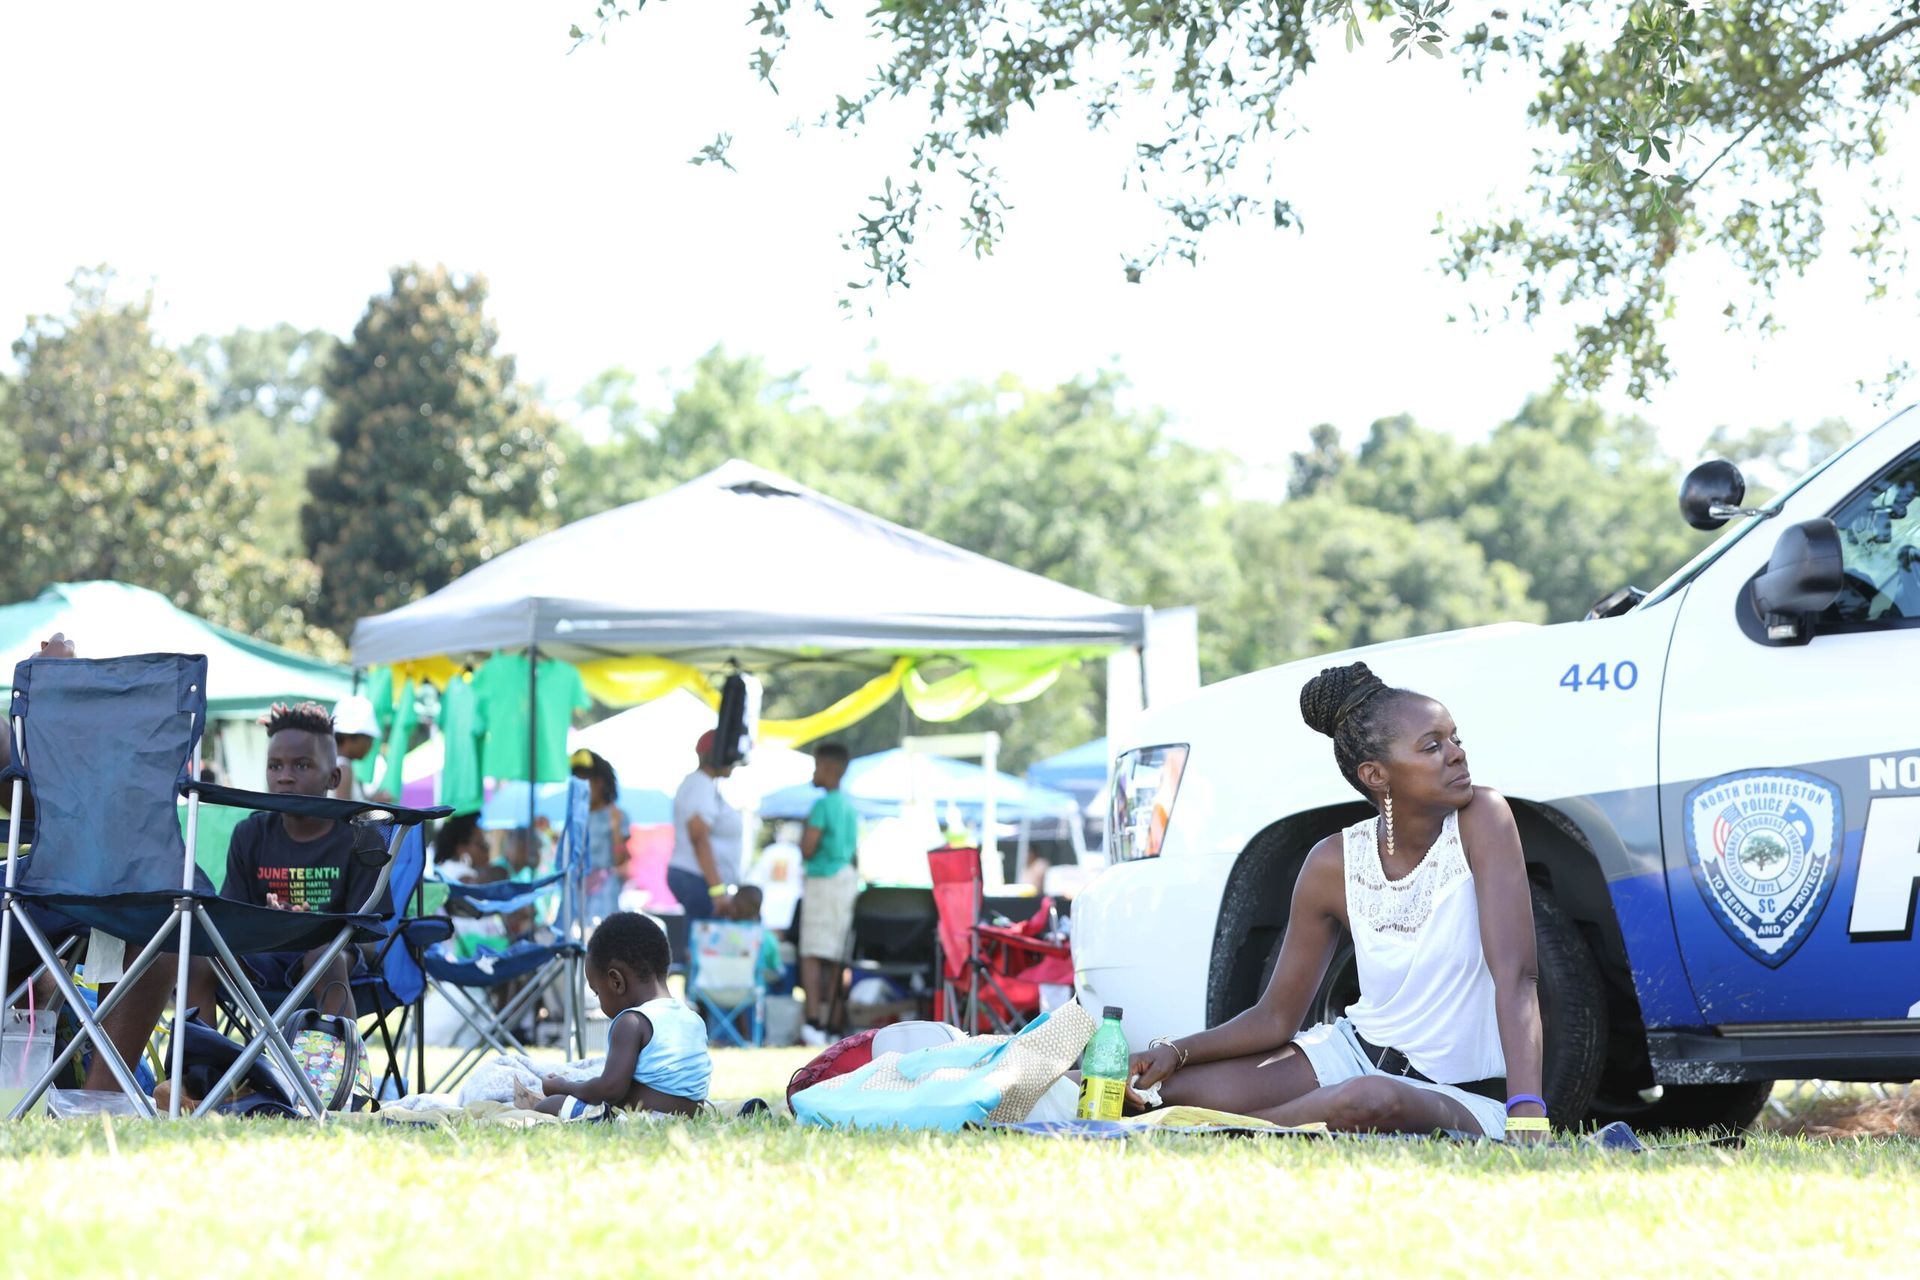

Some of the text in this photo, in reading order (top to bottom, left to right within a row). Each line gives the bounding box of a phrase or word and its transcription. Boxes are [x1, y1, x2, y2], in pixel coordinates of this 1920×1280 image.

[1560, 660, 1638, 692] 440
[1700, 782, 1824, 811] NORTH CHARLESTON
[1741, 797, 1783, 814] POLICE
[257, 867, 340, 879] JUNETEENTH
[1711, 861, 1823, 936] TO SERVE AND TO PROTECT
[1758, 898, 1776, 914] SC
